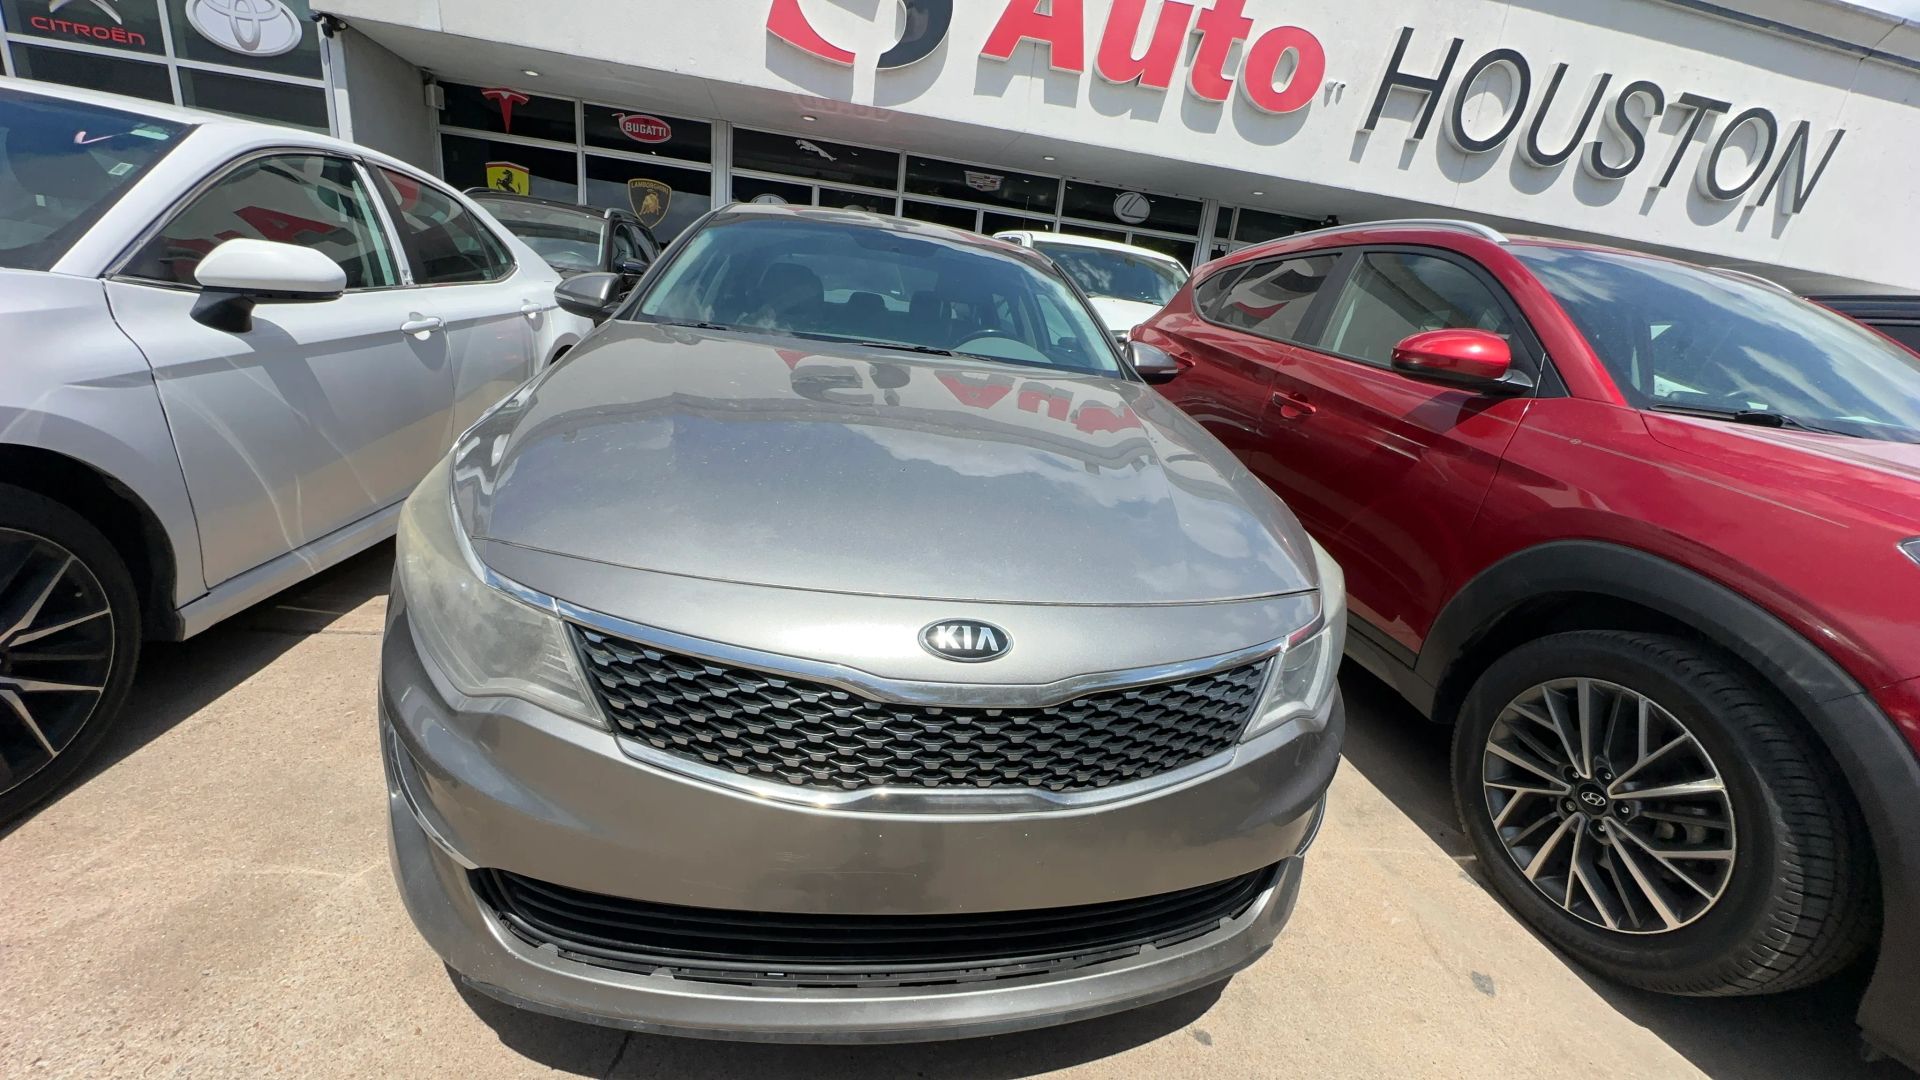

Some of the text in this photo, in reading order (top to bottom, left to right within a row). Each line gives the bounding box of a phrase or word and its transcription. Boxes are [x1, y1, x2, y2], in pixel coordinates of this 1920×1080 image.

[980, 0, 1846, 215] Auto HOUSTON
[625, 122, 666, 136] BUGATTI
[936, 625, 999, 652] KIA
